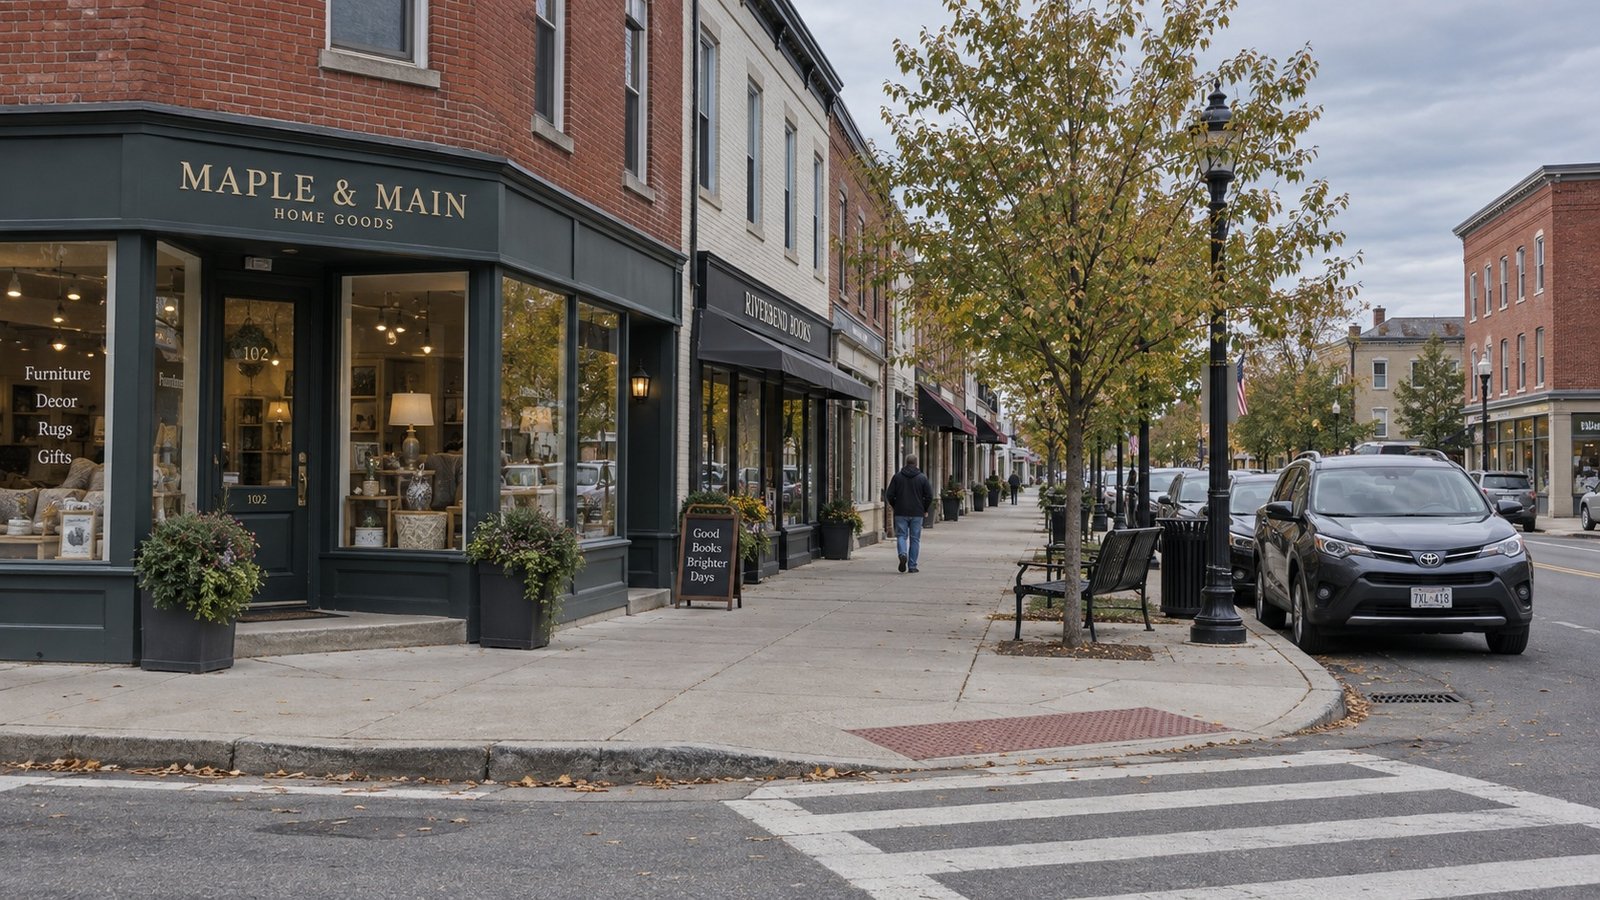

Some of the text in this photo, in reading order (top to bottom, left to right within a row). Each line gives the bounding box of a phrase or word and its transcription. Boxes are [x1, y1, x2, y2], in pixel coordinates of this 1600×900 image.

[180, 161, 467, 220] MAPLE & MAIN
[274, 208, 394, 230] HOME GOODS
[745, 291, 788, 332] RIVERBEND
[790, 314, 811, 343] BOOKS
[244, 346, 269, 361] 102
[24, 366, 91, 381] Furniture
[36, 393, 78, 408] Decor
[38, 421, 73, 440] Rugs
[37, 449, 72, 465] Gifts
[693, 528, 720, 539] Good
[692, 542, 722, 553] Books
[687, 557, 728, 570] Brighter
[690, 571, 715, 584] Days
